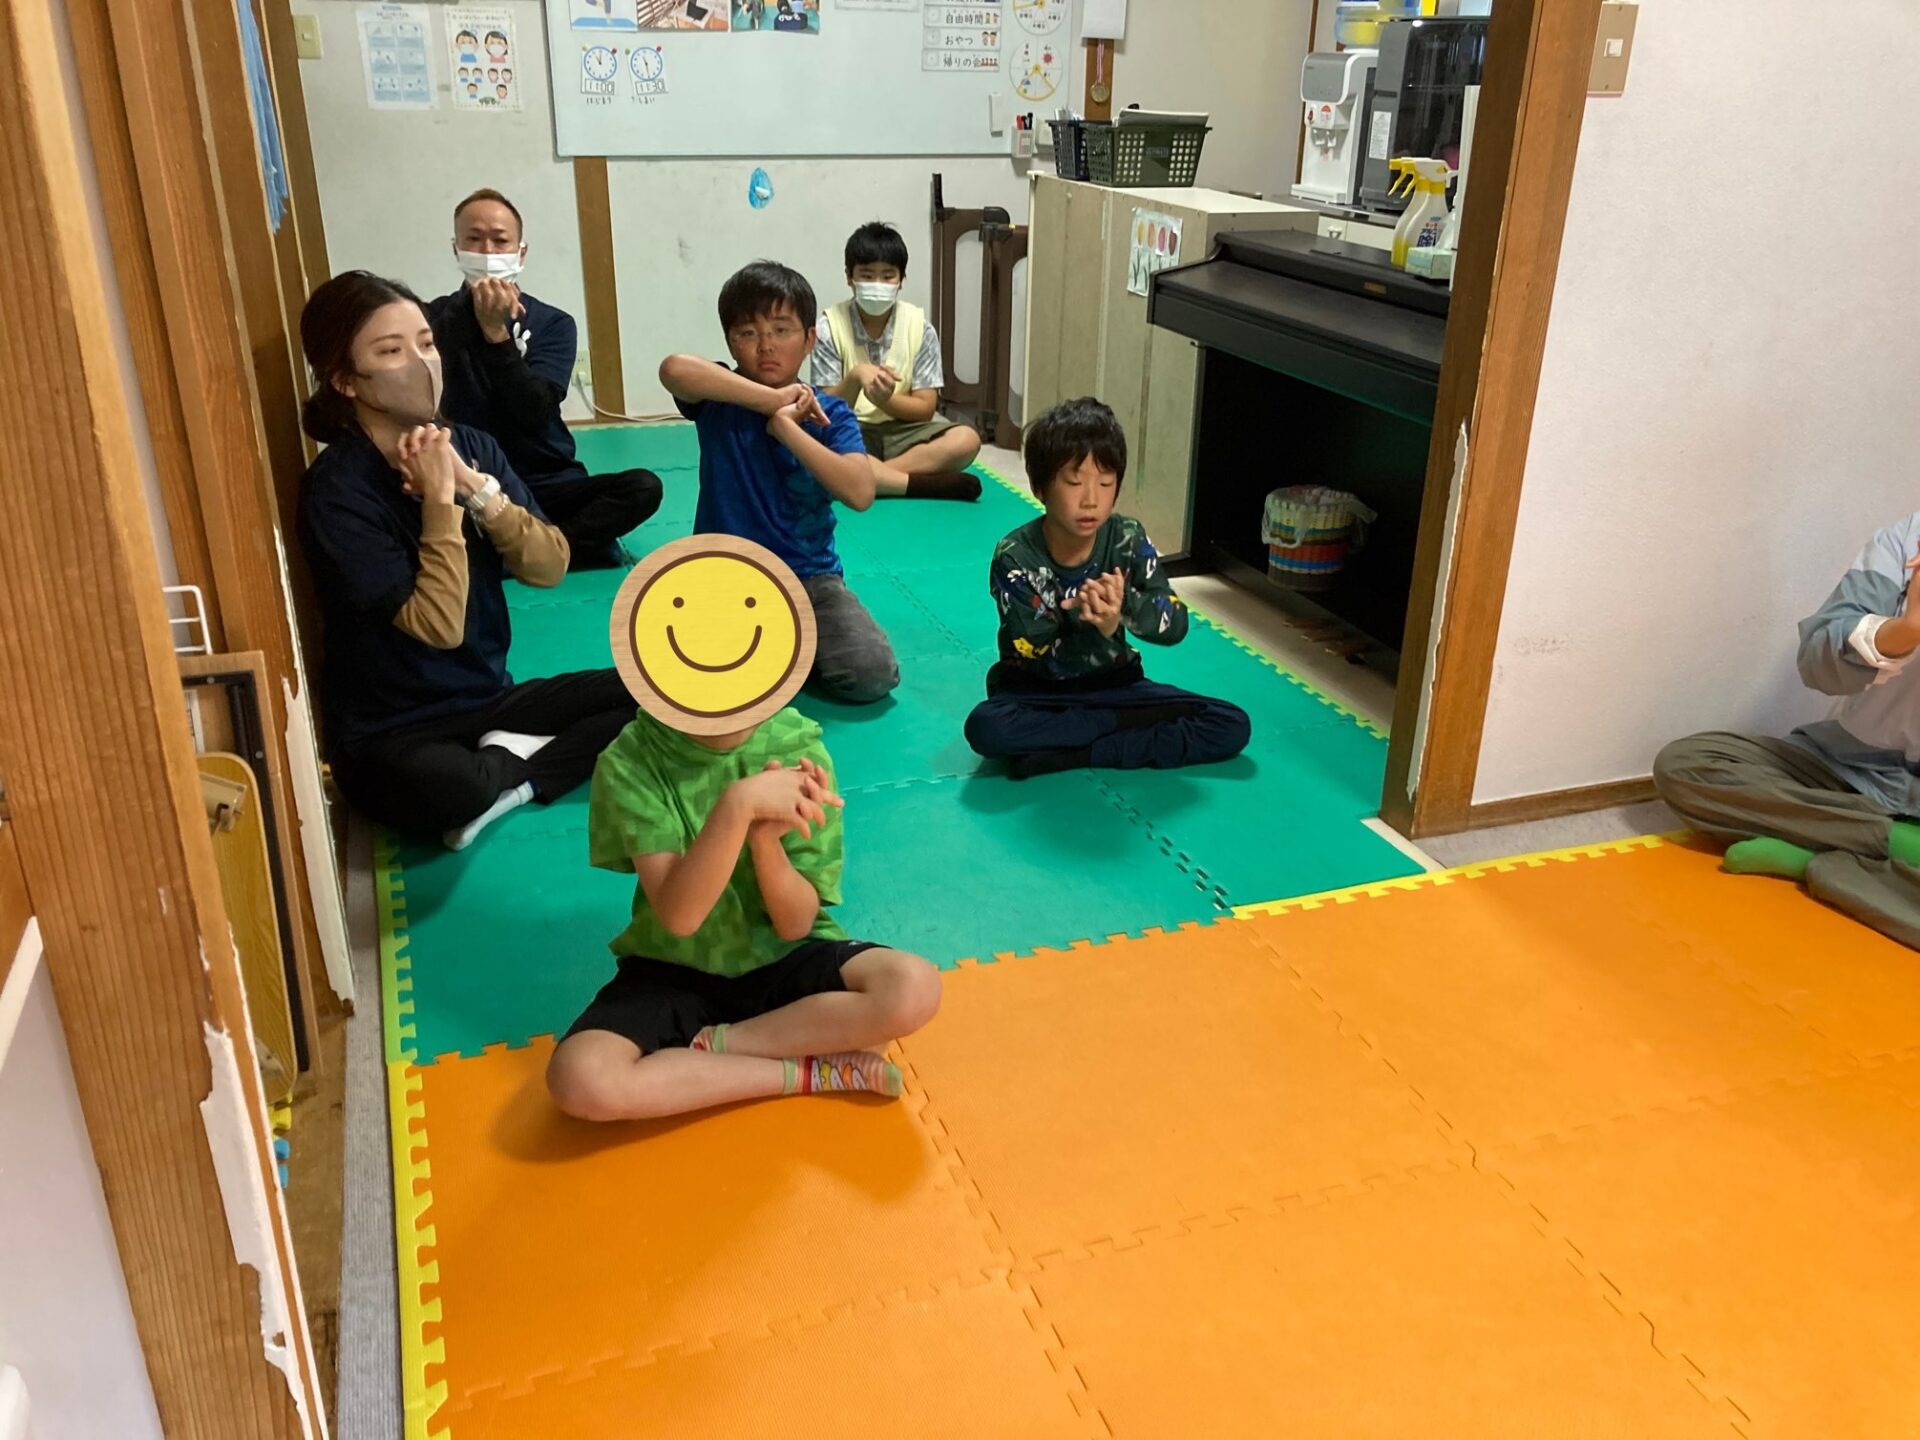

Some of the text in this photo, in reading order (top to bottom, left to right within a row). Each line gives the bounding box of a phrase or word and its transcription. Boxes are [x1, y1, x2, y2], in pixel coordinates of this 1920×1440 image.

[946, 14, 984, 25] 自由時間
[945, 35, 974, 46] おやつ
[943, 56, 982, 67] 帰りの会
